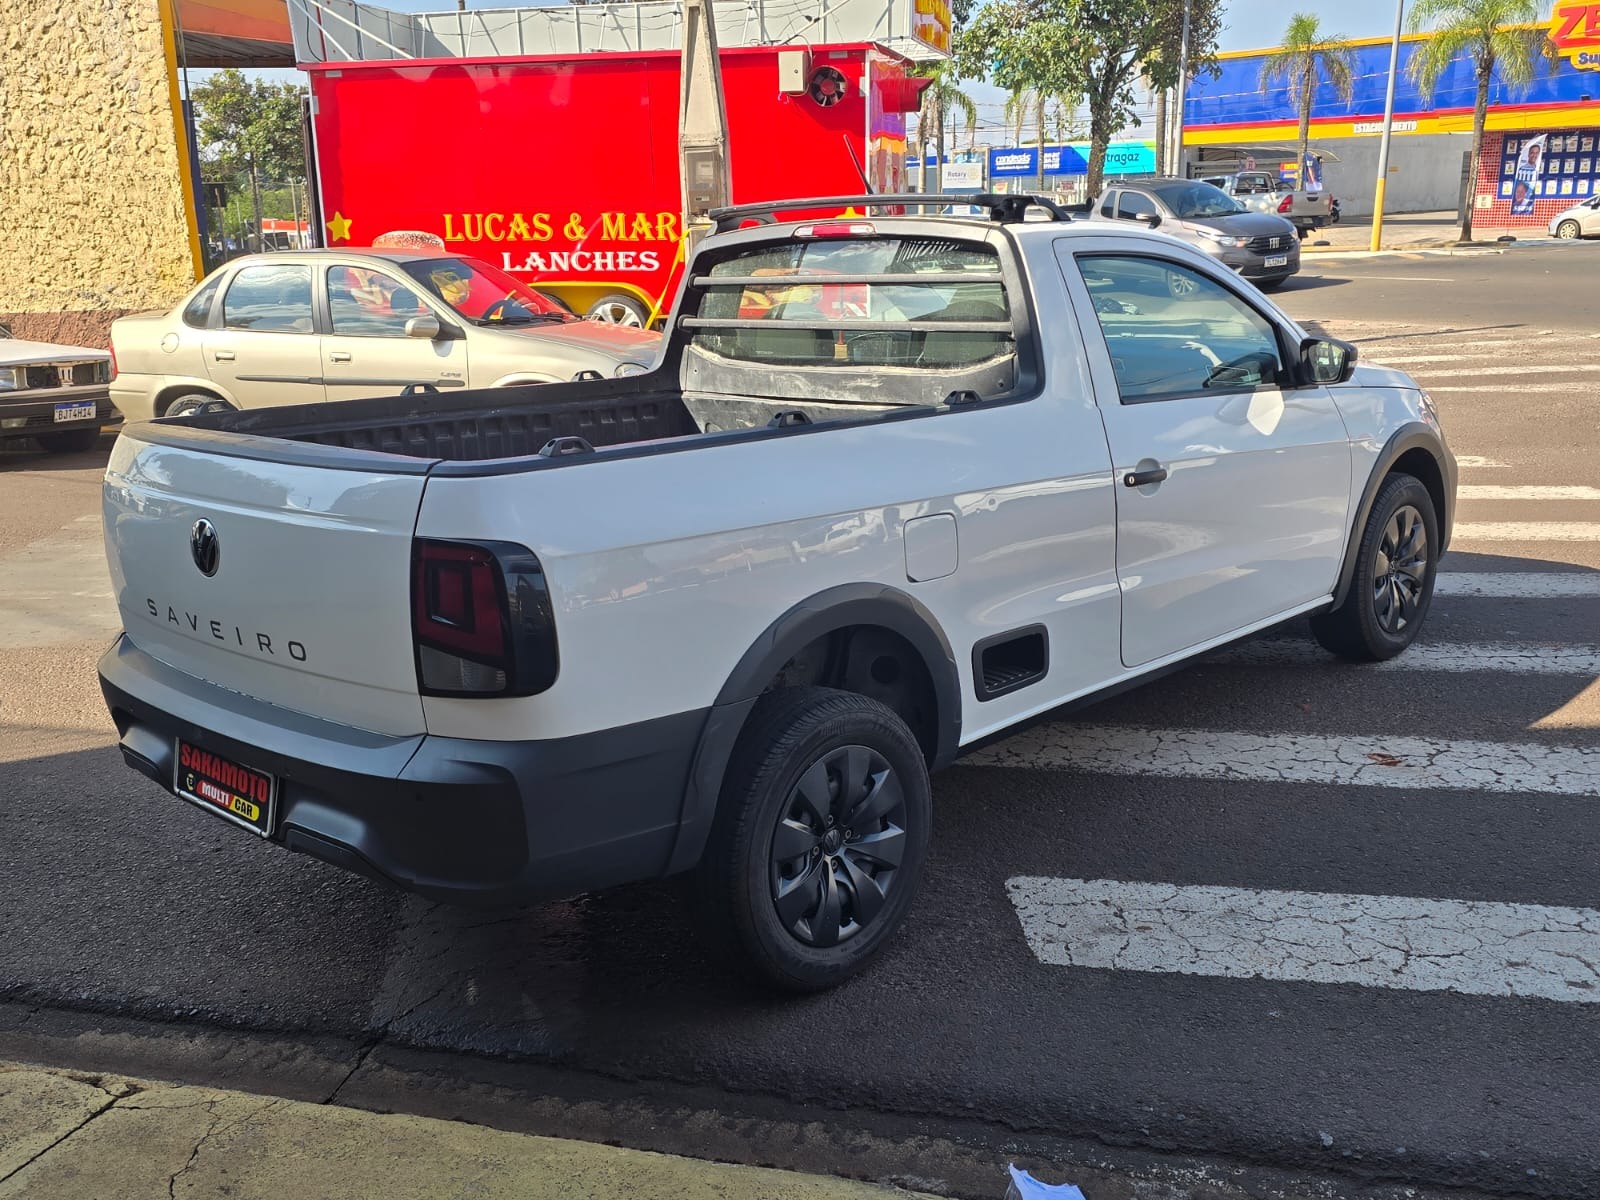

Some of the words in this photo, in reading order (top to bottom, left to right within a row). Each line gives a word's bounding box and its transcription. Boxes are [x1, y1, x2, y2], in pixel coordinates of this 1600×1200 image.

[1578, 52, 1600, 66] Su
[1105, 152, 1140, 166] tragaz
[443, 212, 553, 242] LUCAS
[563, 212, 588, 241] &
[600, 211, 682, 244] MAR
[501, 251, 660, 272] LANCHES
[146, 597, 307, 662] SAVEIRO
[180, 742, 269, 804] SAKAMOTO
[201, 781, 230, 806] MULTI
[234, 797, 254, 818] CAR
